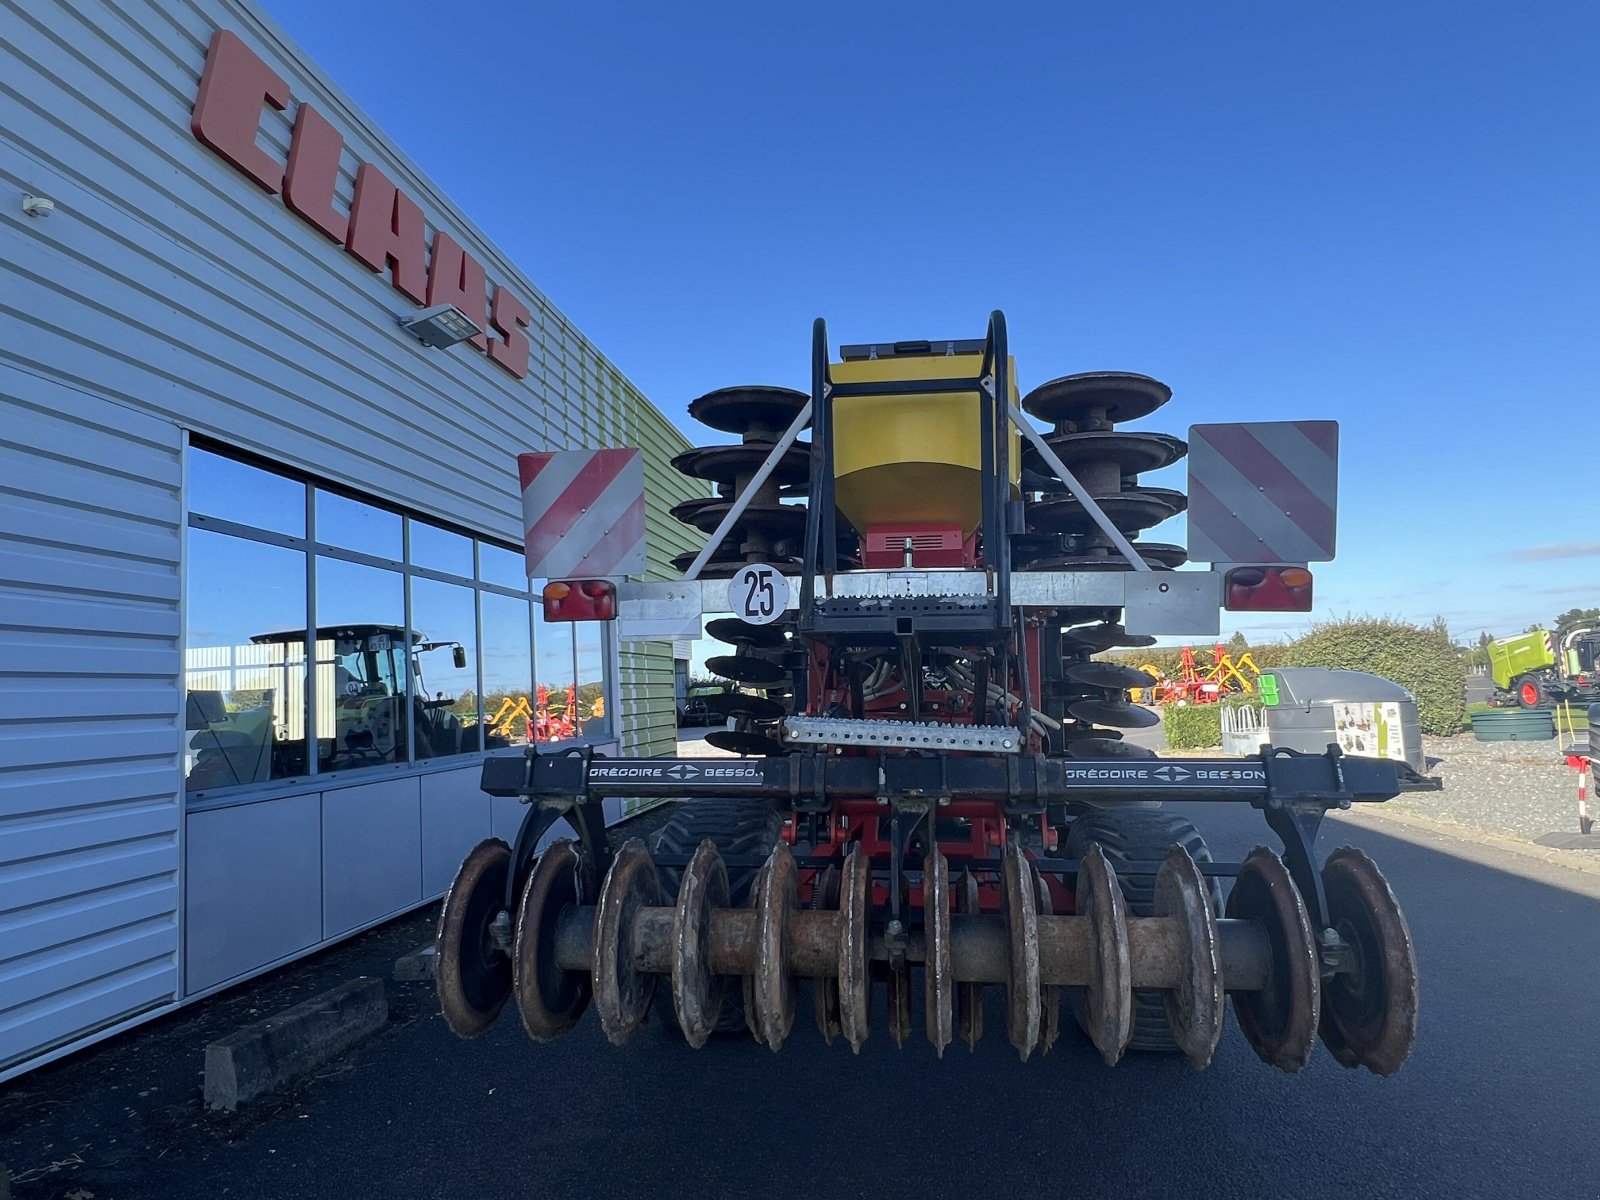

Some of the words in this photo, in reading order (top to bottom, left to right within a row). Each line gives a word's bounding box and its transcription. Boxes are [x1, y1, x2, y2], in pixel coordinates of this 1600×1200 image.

[191, 29, 531, 380] CLAAS
[744, 570, 775, 617] 25
[589, 767, 663, 777] GRÉGOIRE
[704, 768, 764, 777] BESSO
[1196, 770, 1266, 779] BESSON
